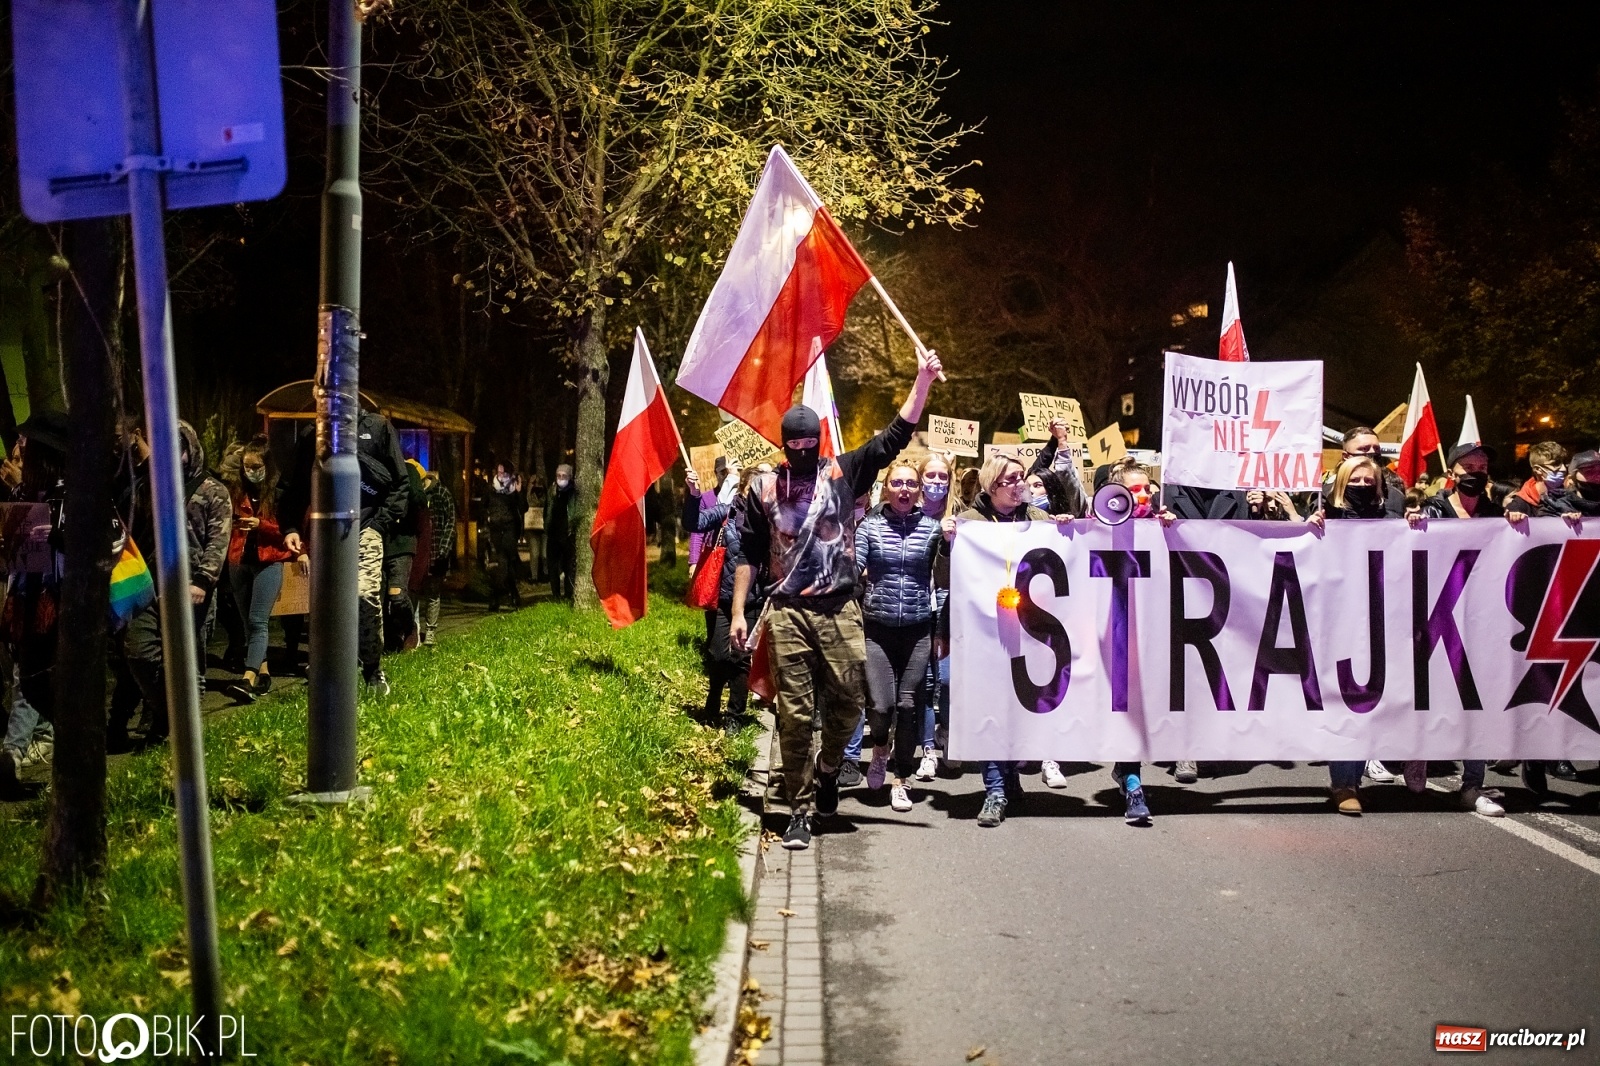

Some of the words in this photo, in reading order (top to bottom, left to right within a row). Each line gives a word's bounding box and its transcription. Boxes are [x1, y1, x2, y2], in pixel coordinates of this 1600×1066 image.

[1023, 394, 1053, 409] REAL
[1054, 398, 1075, 413] MEN
[1172, 375, 1249, 416] WYBÓR
[1039, 409, 1065, 420] ARE
[1214, 419, 1250, 451] NIE
[1237, 452, 1322, 488] ZAKAZ
[1010, 547, 1484, 714] STRAJK
